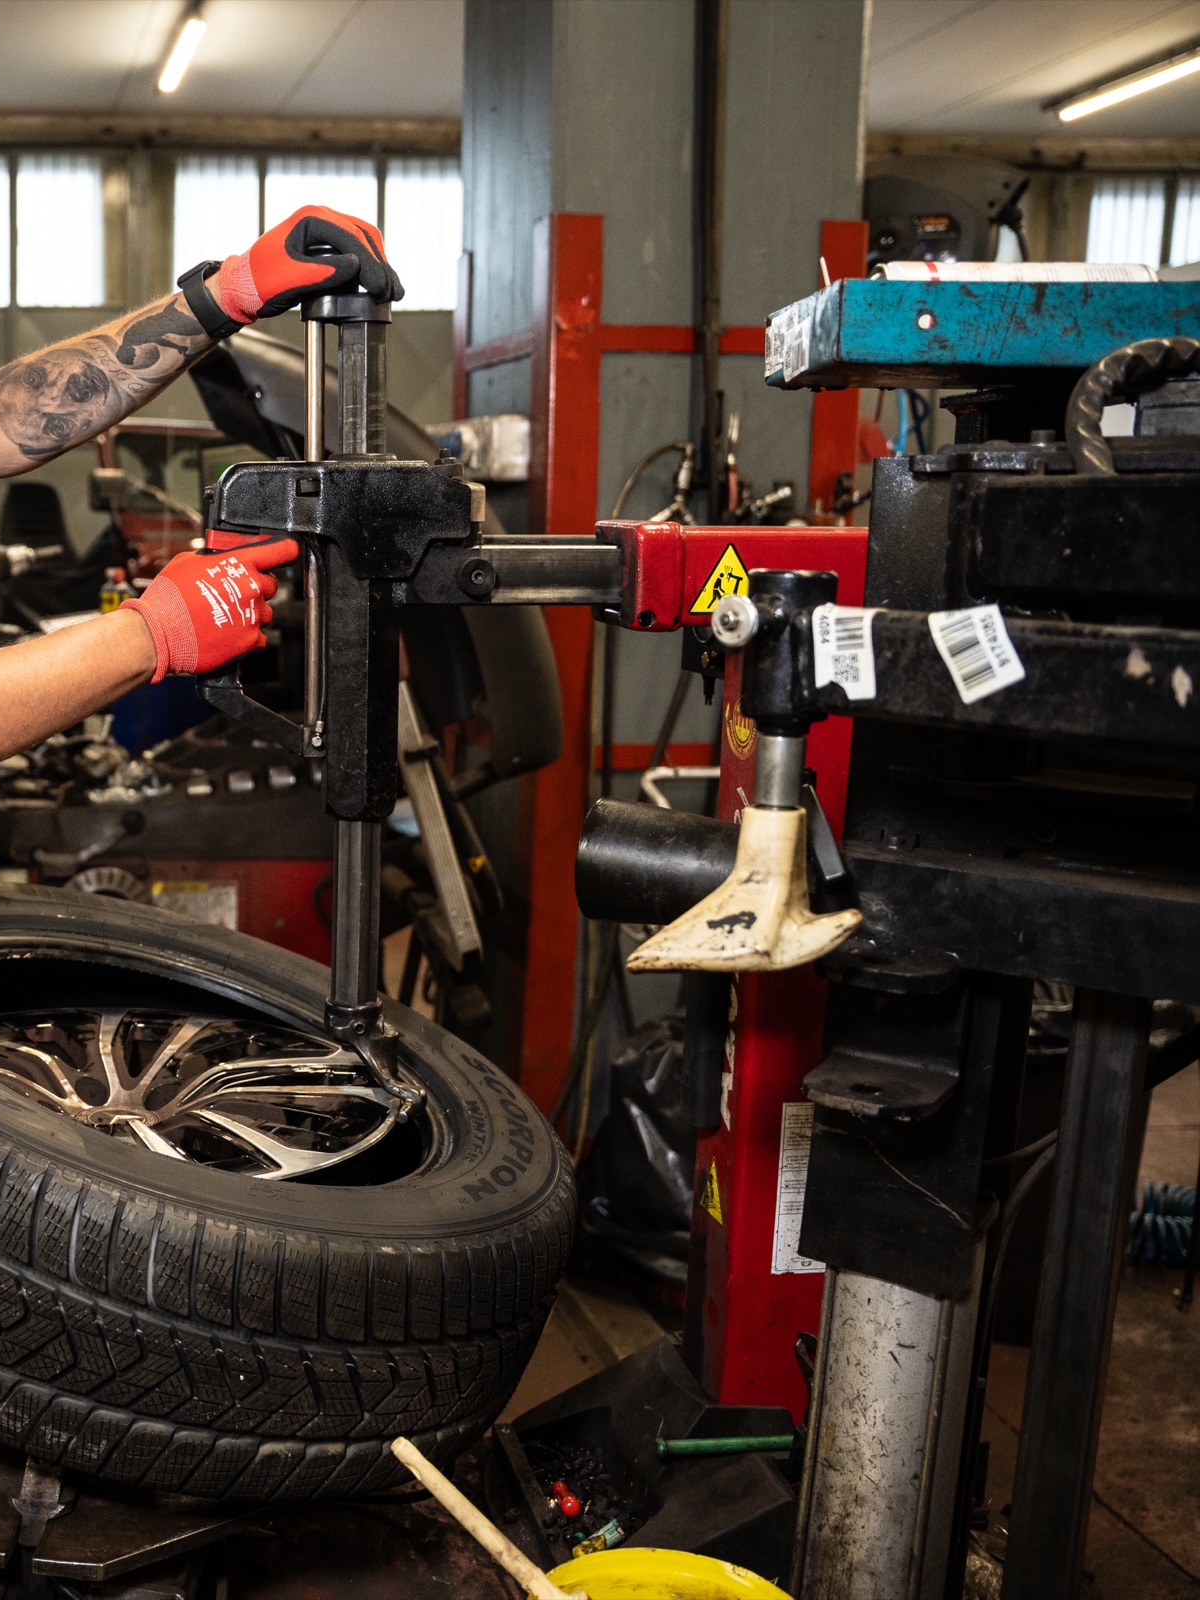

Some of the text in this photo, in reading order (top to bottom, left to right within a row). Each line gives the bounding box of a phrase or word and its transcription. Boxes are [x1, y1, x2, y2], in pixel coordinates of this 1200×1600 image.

[196, 581, 228, 628] Milwaukee
[460, 1053, 535, 1202] SCORPION
[466, 1100, 488, 1163] WINTER
